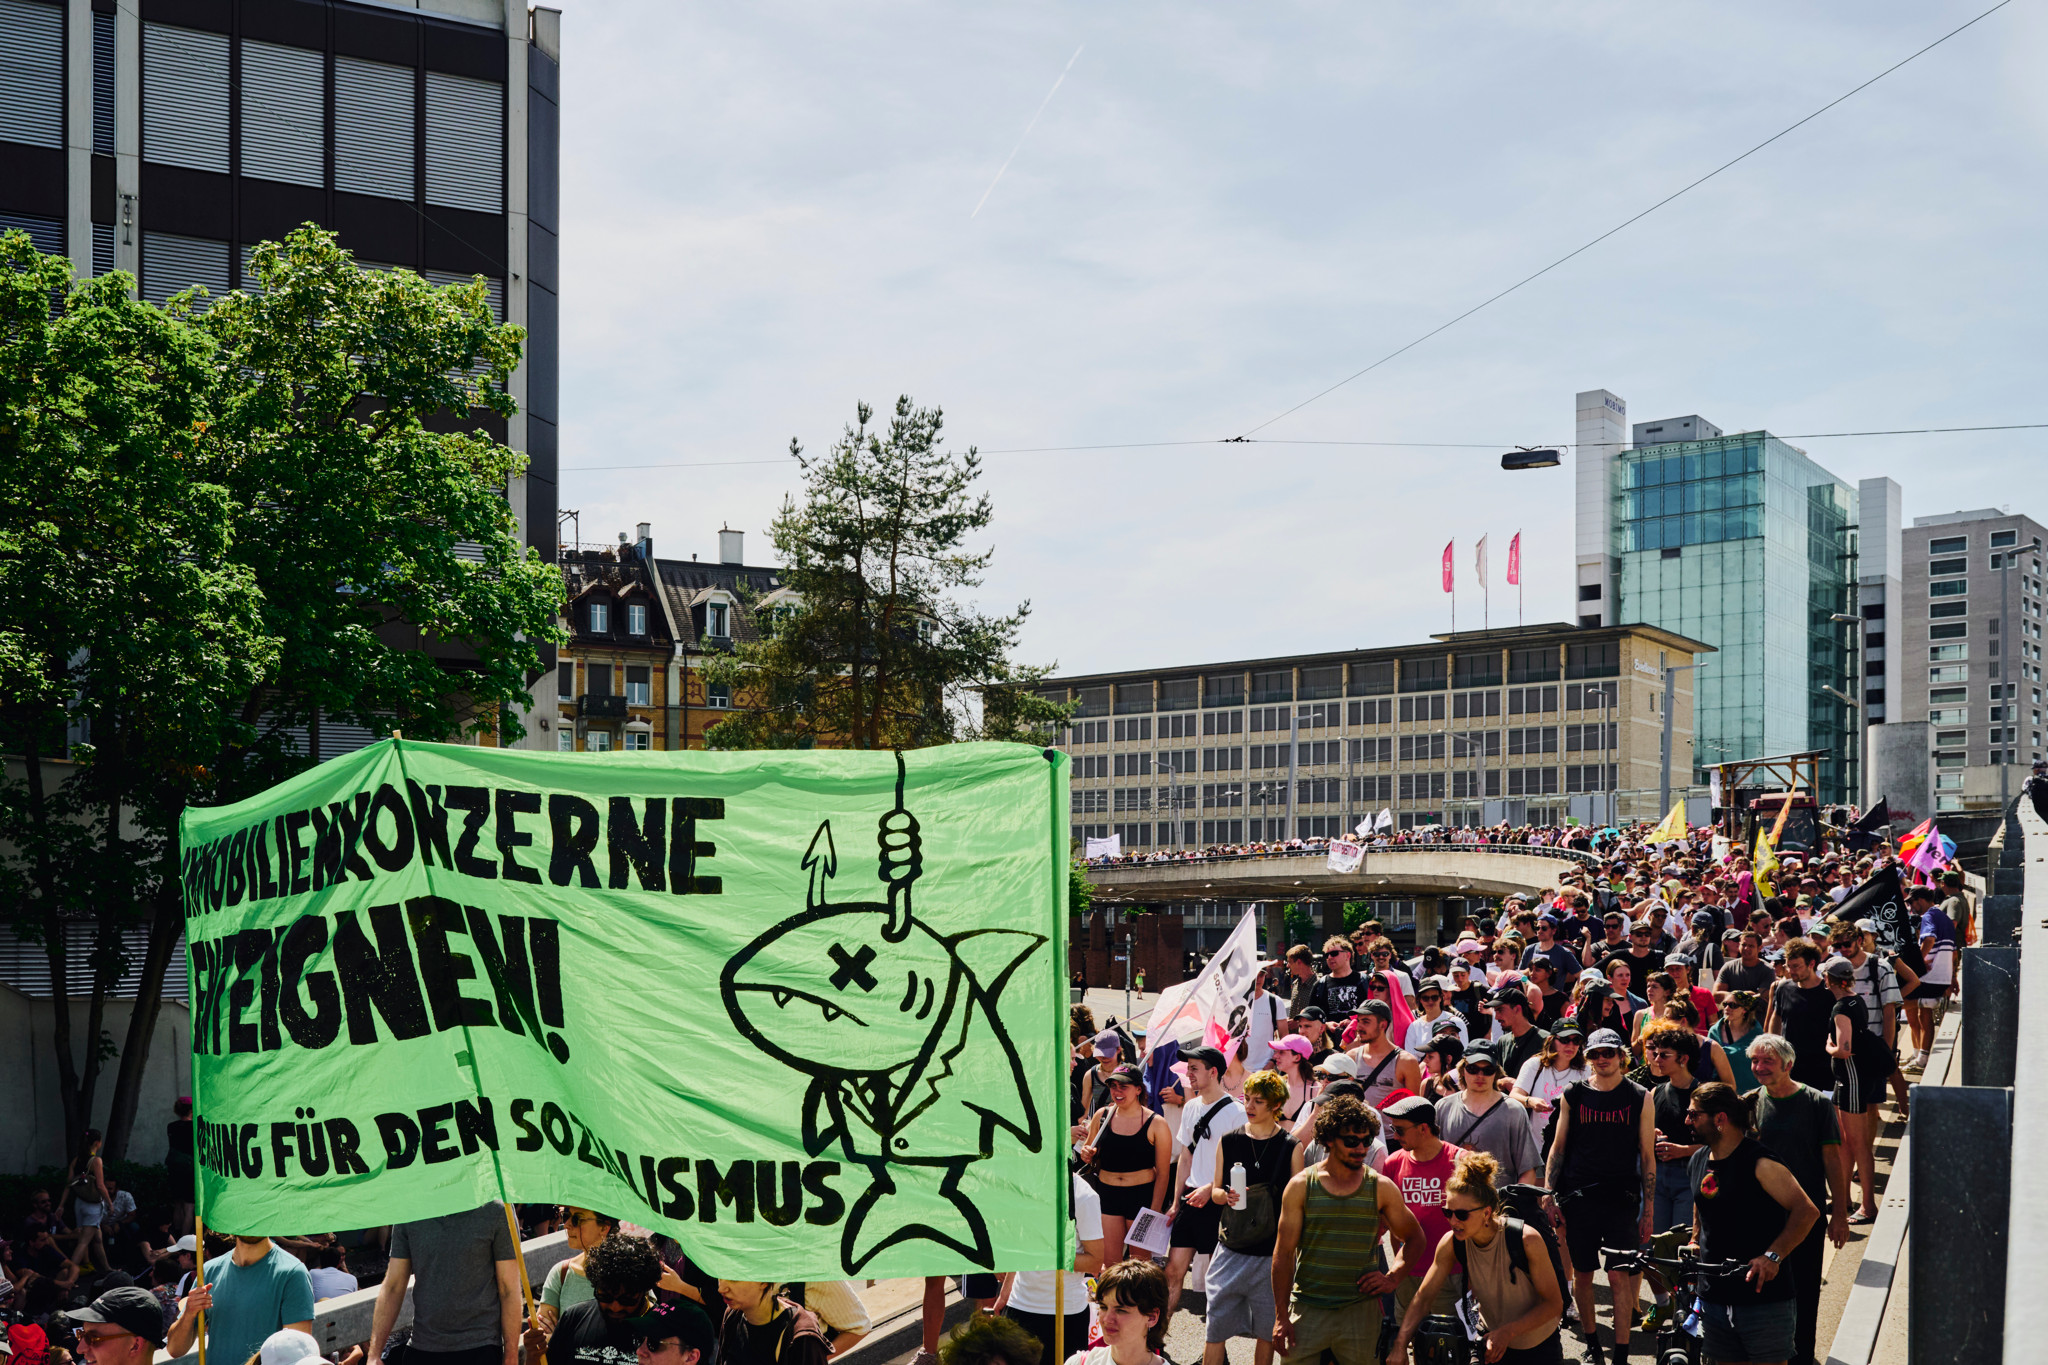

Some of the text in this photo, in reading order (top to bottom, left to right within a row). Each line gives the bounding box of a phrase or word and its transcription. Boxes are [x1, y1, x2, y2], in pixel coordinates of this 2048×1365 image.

[1604, 396, 1625, 415] MOBIMO
[190, 894, 570, 1064] ENTEIGNEN!
[1579, 1103, 1631, 1126] DIFFERENT
[270, 1106, 371, 1178] FÜR
[373, 1096, 500, 1170] DEN
[510, 1098, 846, 1227] SOZIALISMUS
[1402, 1176, 1441, 1191] VELO
[1403, 1189, 1441, 1204] LOVE
